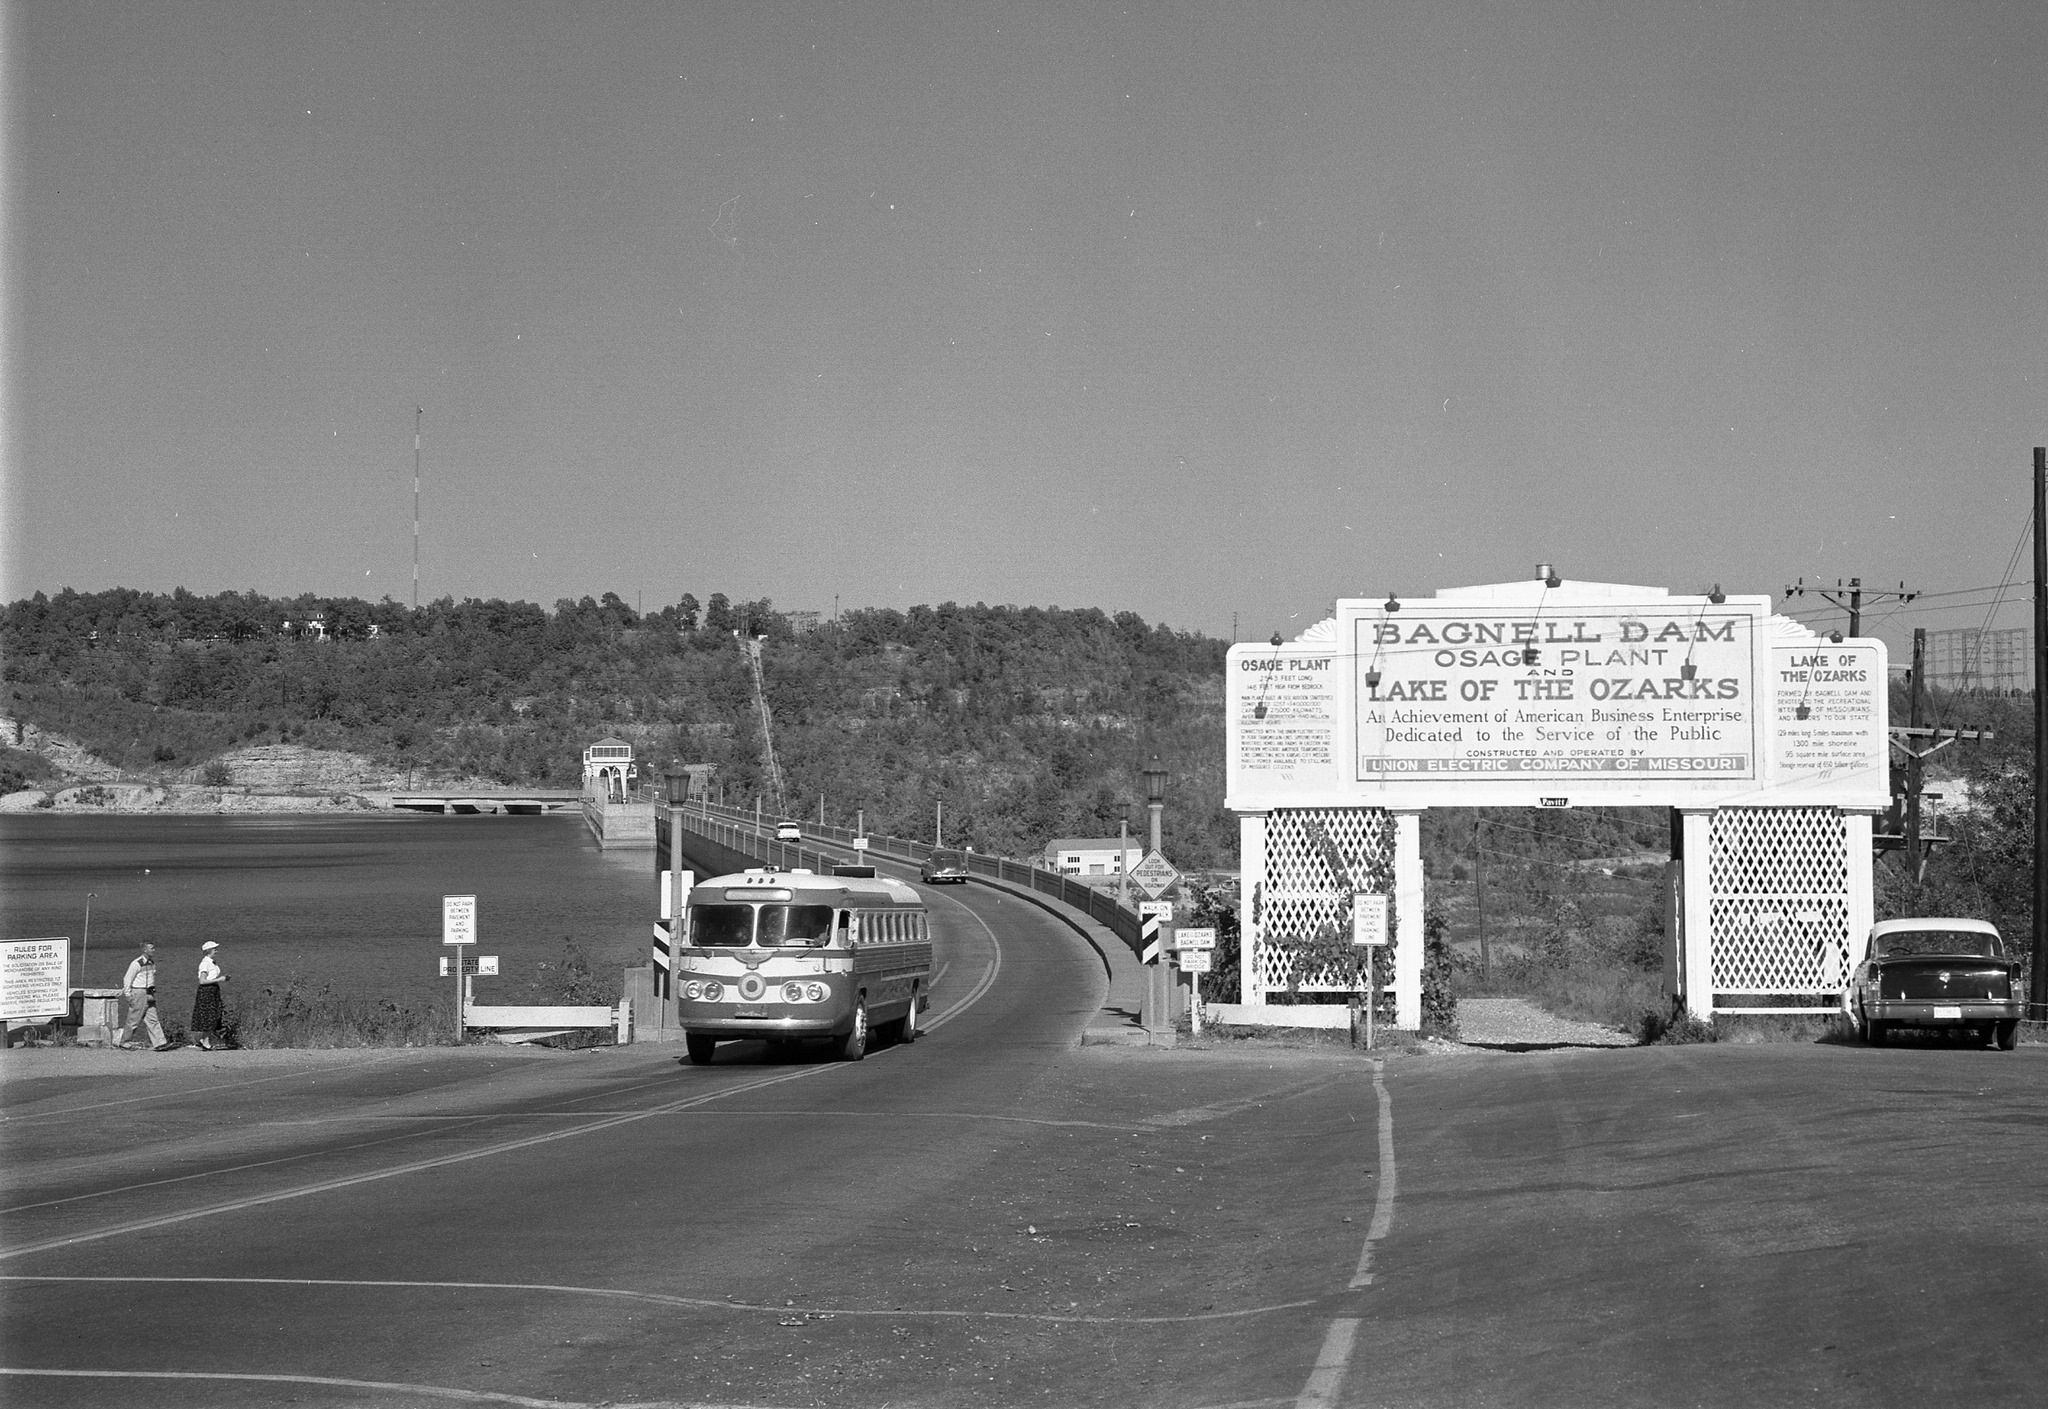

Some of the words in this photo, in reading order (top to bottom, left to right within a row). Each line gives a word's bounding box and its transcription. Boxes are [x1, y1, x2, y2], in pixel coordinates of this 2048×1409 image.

[1372, 621, 1602, 645] BAGNELL
[1619, 620, 1736, 643] DAM
[1434, 650, 1542, 668] OSAGE
[1560, 649, 1669, 667] PLANT
[1790, 655, 1829, 667] LAKE
[1838, 655, 1857, 667] OF
[1241, 659, 1284, 672] OSAGE
[1289, 659, 1331, 671] PLANT
[1281, 674, 1296, 682] FEET
[1297, 674, 1313, 682] LONG
[1526, 668, 1574, 677] AND
[1780, 670, 1808, 682] THE
[1814, 669, 1867, 682] OZARKS
[1368, 679, 1448, 702] LAKE
[1460, 679, 1499, 702] OF
[1513, 678, 1574, 701] THE
[1589, 677, 1740, 701] OZARKS
[1844, 689, 1858, 697] DAM
[1366, 710, 1386, 724] An
[1391, 709, 1489, 724] Achievement
[1494, 709, 1508, 723] of
[1514, 709, 1584, 723] American
[1591, 708, 1655, 723] Business
[1662, 707, 1742, 725] Enterprise
[1385, 727, 1463, 742] Dedicated
[1476, 728, 1491, 742] to
[1502, 726, 1525, 742] the
[1535, 726, 1595, 741] Service
[1606, 726, 1621, 741] of
[1633, 726, 1658, 741] the
[1670, 725, 1722, 741] Public
[1466, 749, 1537, 757] CONSTRUCTED
[1372, 759, 1419, 771] UNION
[1427, 759, 1509, 771] ELECTRIC
[1519, 758, 1606, 771] COMPANY
[1615, 758, 1640, 770] OF
[1648, 758, 1738, 770] MISSOURI
[1136, 869, 1173, 877] PEDESTRIANS
